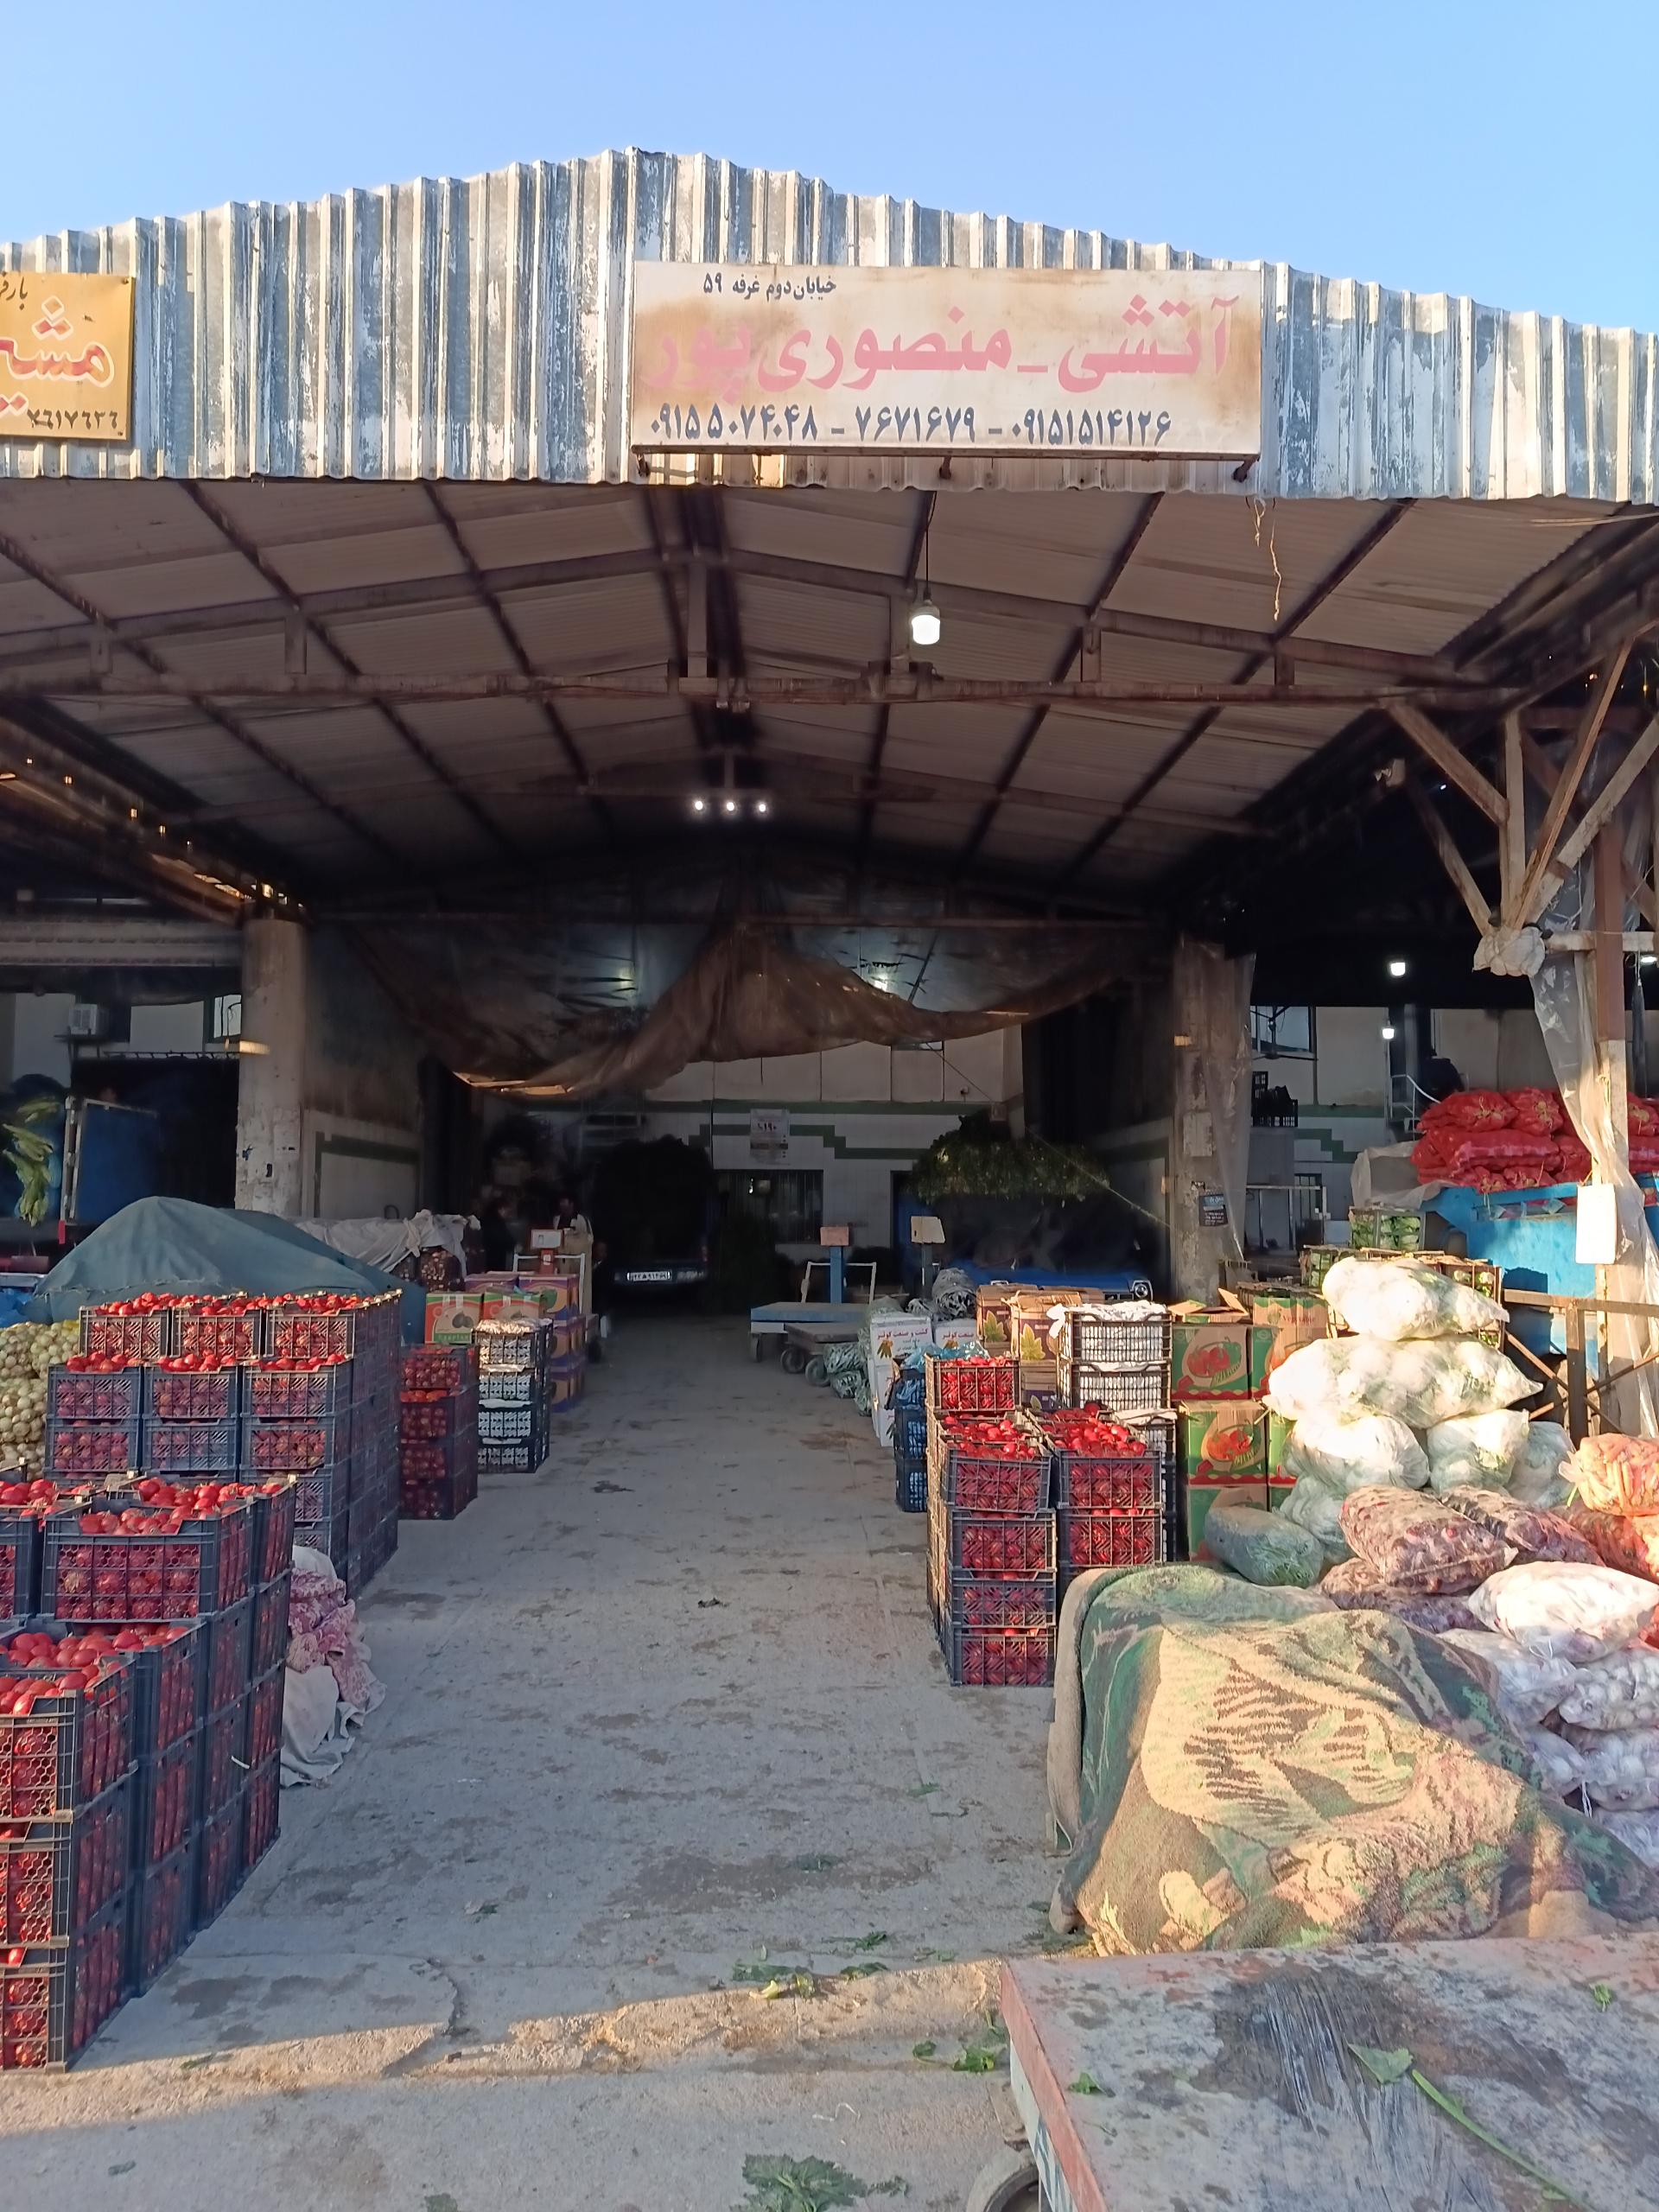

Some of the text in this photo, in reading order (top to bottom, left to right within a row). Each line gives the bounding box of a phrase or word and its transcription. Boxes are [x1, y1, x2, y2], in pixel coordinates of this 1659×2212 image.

[703, 272, 836, 302] خیابان دوم غرفه ۵۹
[640, 323, 752, 404] پور
[758, 304, 1012, 392] منصوری
[1058, 294, 1240, 392] آتشی
[855, 405, 976, 442] ۷۶۷۱۶۷۹
[1012, 408, 1172, 446] ۰۹۱۵۱۵۱۴۱۲۶
